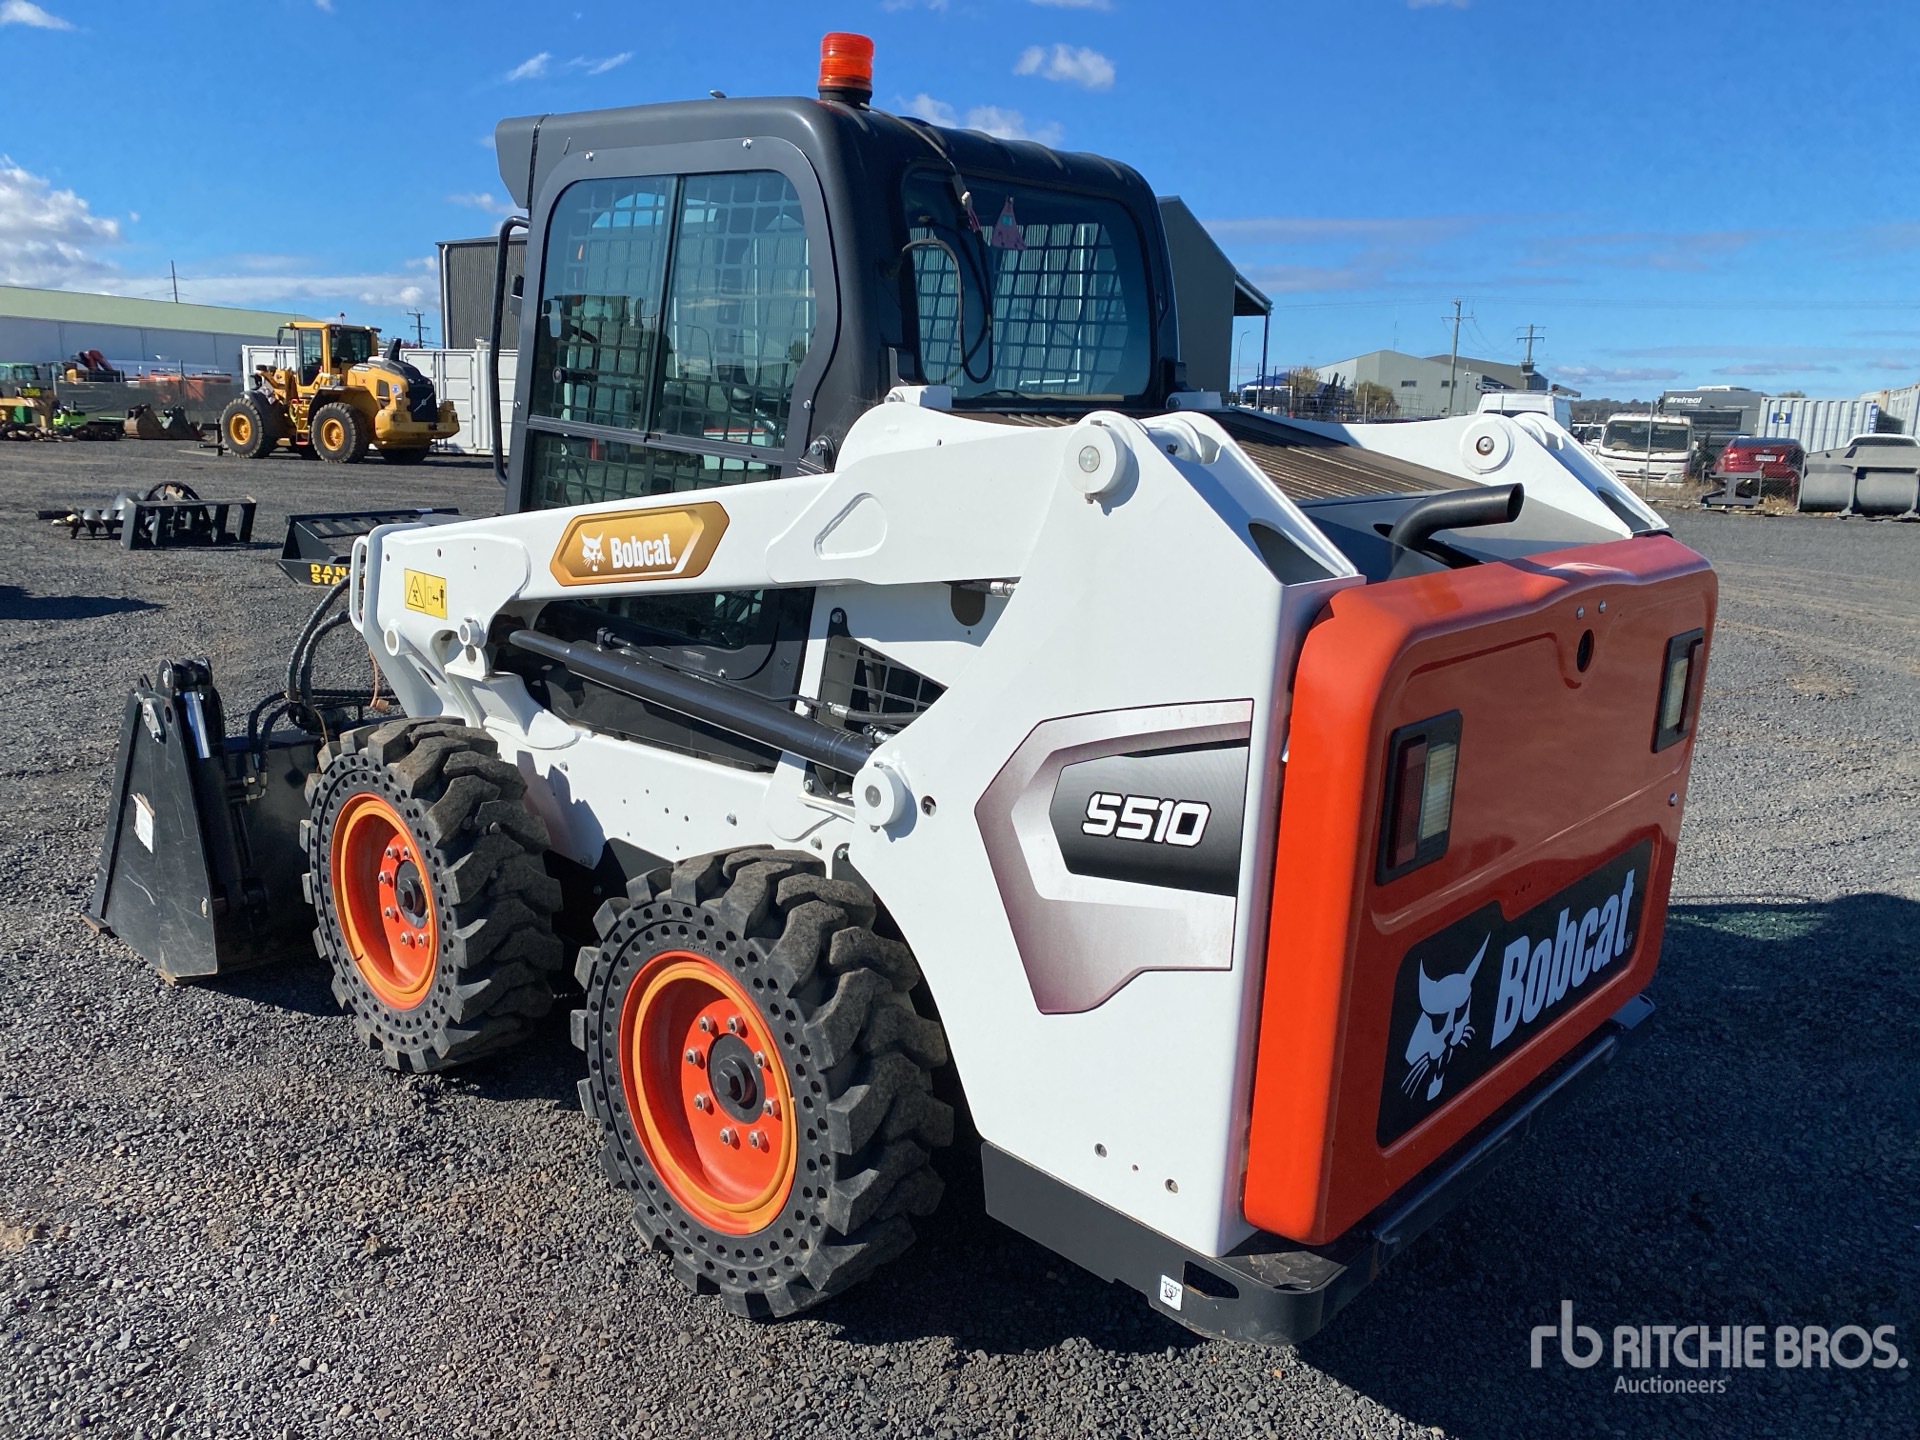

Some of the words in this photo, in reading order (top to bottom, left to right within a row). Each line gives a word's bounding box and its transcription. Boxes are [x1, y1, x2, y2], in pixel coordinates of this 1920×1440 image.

[310, 564, 351, 576] DAN
[609, 533, 673, 569] Bobcat
[1081, 791, 1212, 849] S510
[1490, 868, 1636, 1051] Bobcat
